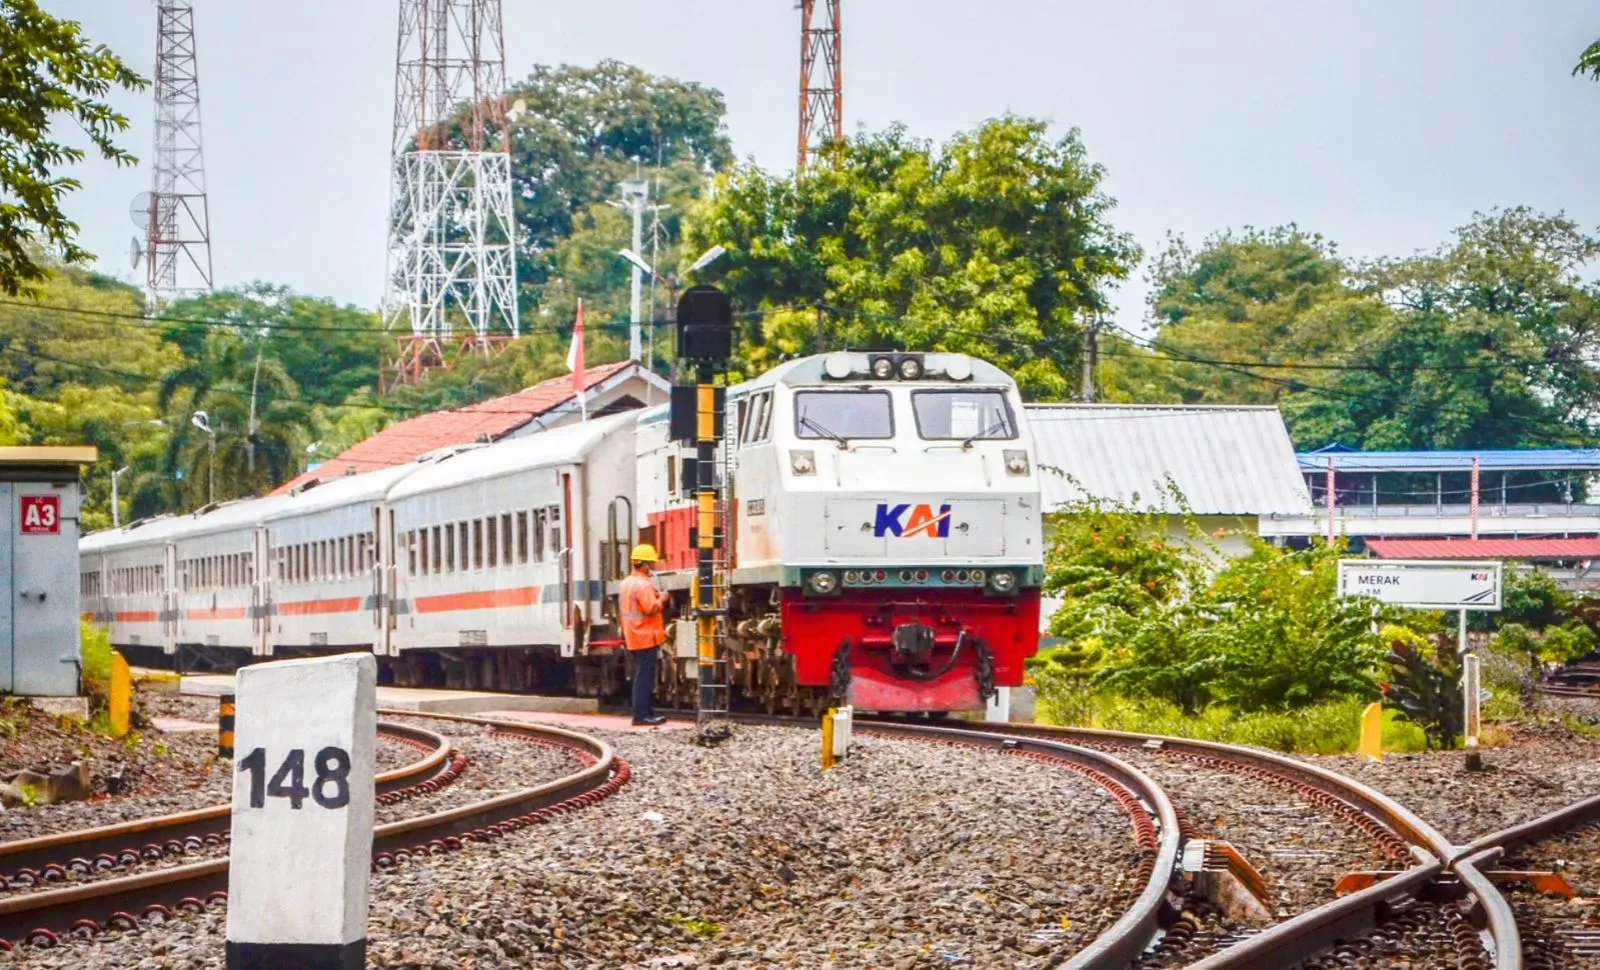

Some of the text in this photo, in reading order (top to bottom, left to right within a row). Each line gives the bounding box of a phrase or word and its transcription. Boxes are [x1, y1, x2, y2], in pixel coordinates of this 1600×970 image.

[25, 504, 55, 526] A3
[874, 503, 951, 538] KAI
[1358, 575, 1400, 585] MERAK
[238, 746, 351, 810] 148
